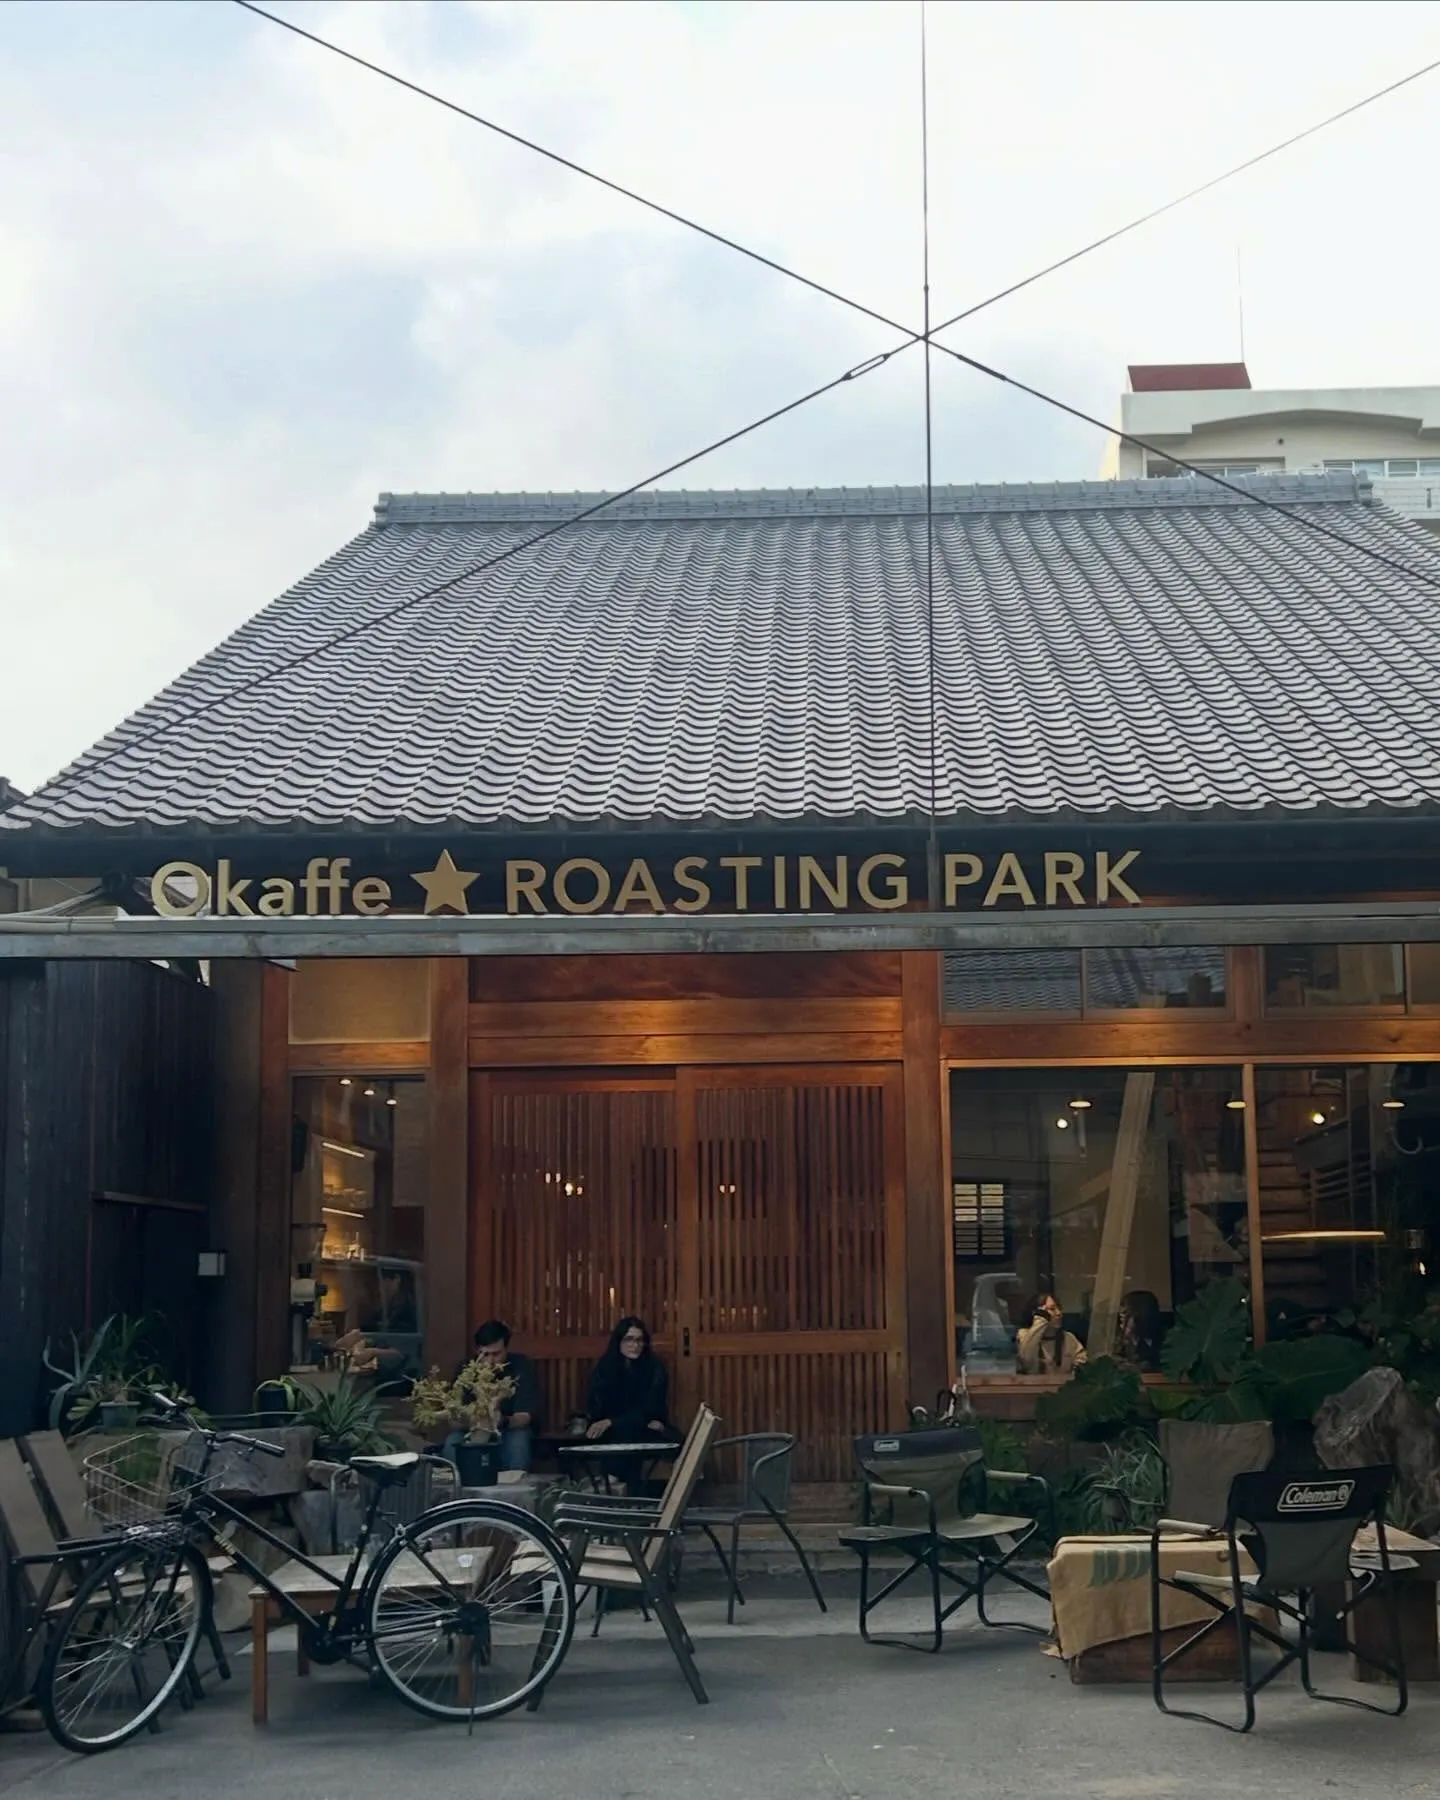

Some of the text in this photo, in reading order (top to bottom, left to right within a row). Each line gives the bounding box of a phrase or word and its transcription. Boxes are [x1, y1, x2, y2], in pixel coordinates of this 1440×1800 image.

[150, 851, 1142, 918] Okaffe ROASTING PARK
